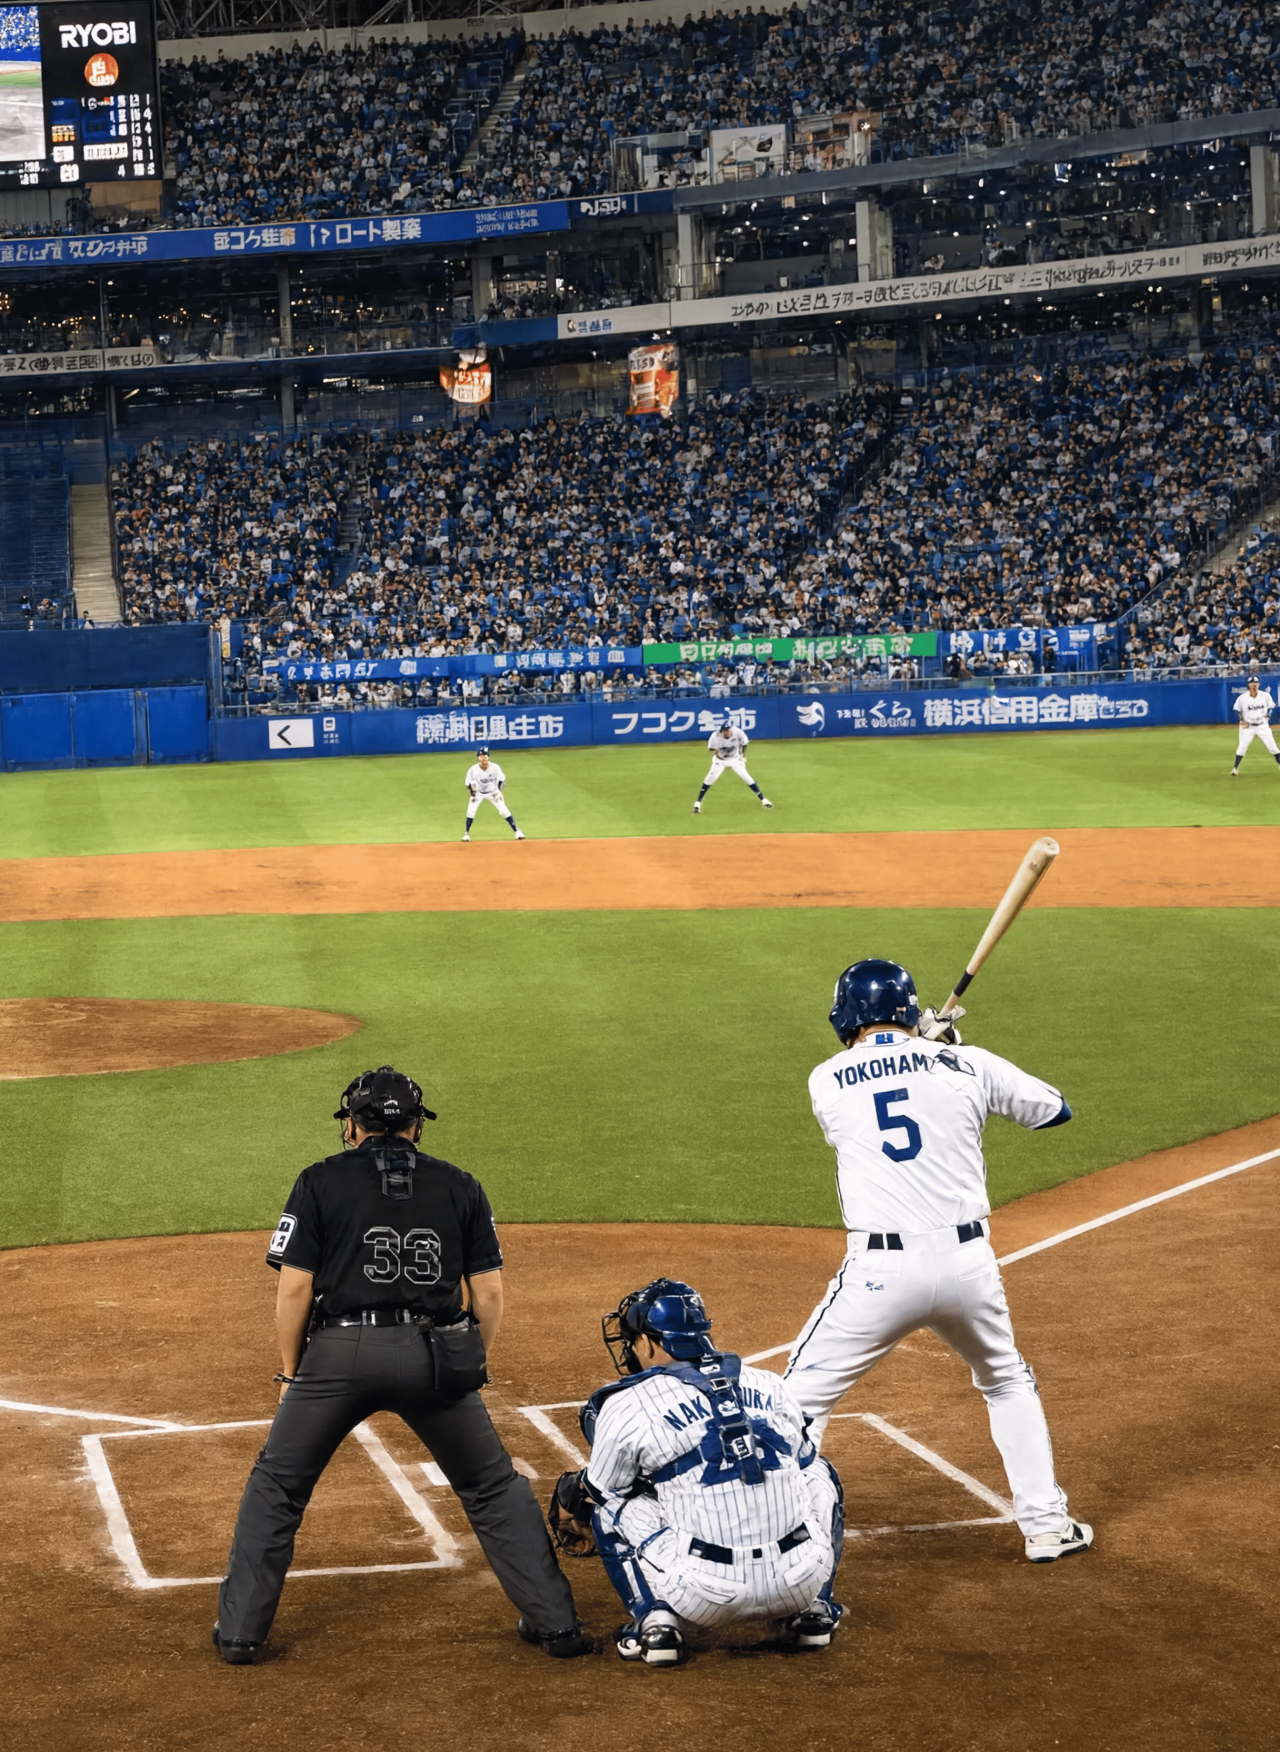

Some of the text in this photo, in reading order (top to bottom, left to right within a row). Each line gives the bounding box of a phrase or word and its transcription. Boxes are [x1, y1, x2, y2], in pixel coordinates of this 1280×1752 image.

[59, 21, 136, 48] RYOBI
[873, 1087, 923, 1163] 5
[364, 1226, 441, 1285] 33
